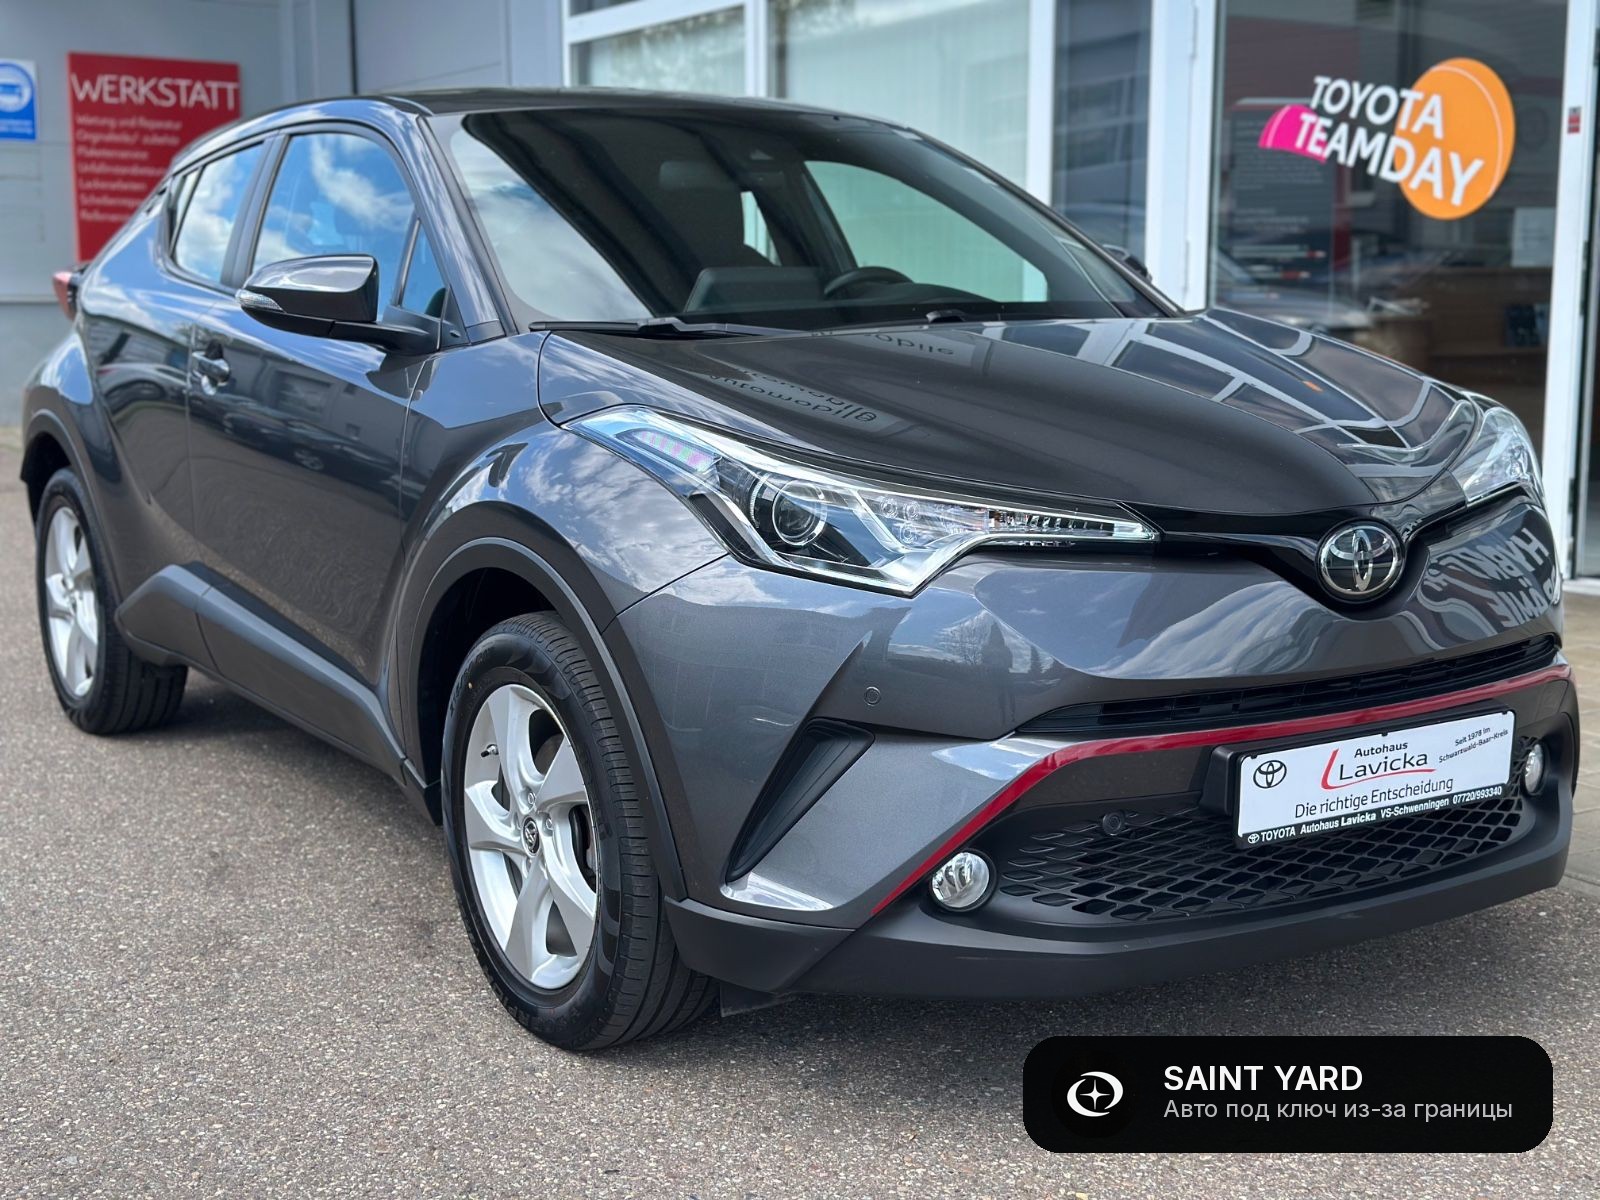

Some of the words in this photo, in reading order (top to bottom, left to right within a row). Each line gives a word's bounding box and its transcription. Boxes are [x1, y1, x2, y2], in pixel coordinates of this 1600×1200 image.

[70, 73, 240, 110] WERKSTATT
[1310, 76, 1444, 140] TOYOTA
[1294, 113, 1485, 207] TEAMDAY
[1354, 742, 1408, 758] Autohaus
[1455, 736, 1467, 746] Seit
[1468, 729, 1482, 741] 1978
[1483, 727, 1491, 735] im
[1339, 752, 1428, 780] Lavicka
[1260, 826, 1296, 842] TOYOTA
[1300, 819, 1339, 835] Autohaus
[1341, 811, 1377, 827] Lavicka
[1380, 798, 1449, 819] VS-Schwenningen
[1452, 786, 1502, 804] 07720/993340
[1295, 802, 1317, 818] Die
[1320, 794, 1368, 814] richtige
[1371, 778, 1454, 803] Entscheidung
